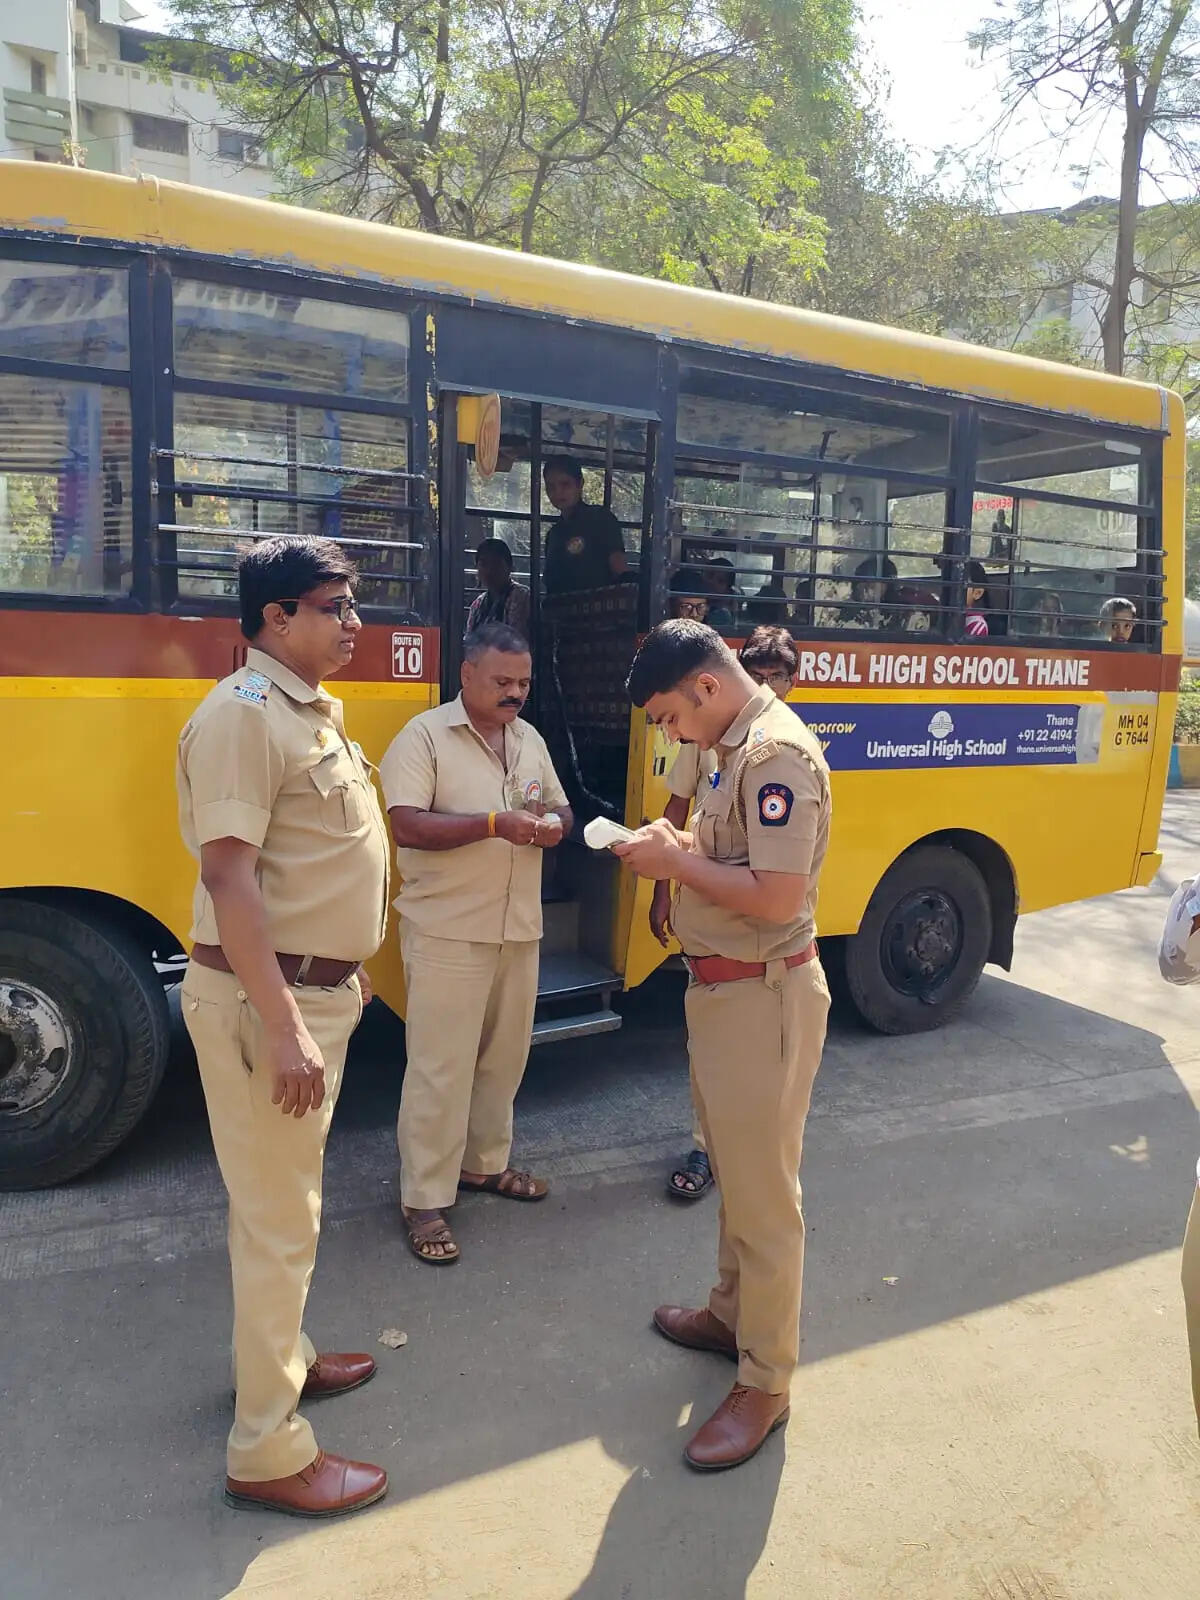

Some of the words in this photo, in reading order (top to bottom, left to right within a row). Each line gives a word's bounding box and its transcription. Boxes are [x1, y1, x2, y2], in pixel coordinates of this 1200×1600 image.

[394, 636, 413, 646] ROUTE
[413, 637, 421, 647] NO
[394, 646, 421, 673] 10
[799, 651, 862, 683] RSAL
[868, 654, 927, 684] HIGH
[932, 655, 1019, 685] SCHOOL
[1025, 658, 1090, 686] THANE
[1046, 713, 1074, 726] Thane
[1118, 714, 1135, 729] MH
[1137, 713, 1149, 729] 04
[807, 722, 857, 734] morrow
[1050, 729, 1073, 741] 4194
[1114, 731, 1123, 746] G
[1126, 730, 1149, 746] 7644
[866, 740, 931, 758] Universal
[932, 738, 963, 760] High
[964, 738, 1007, 756] School
